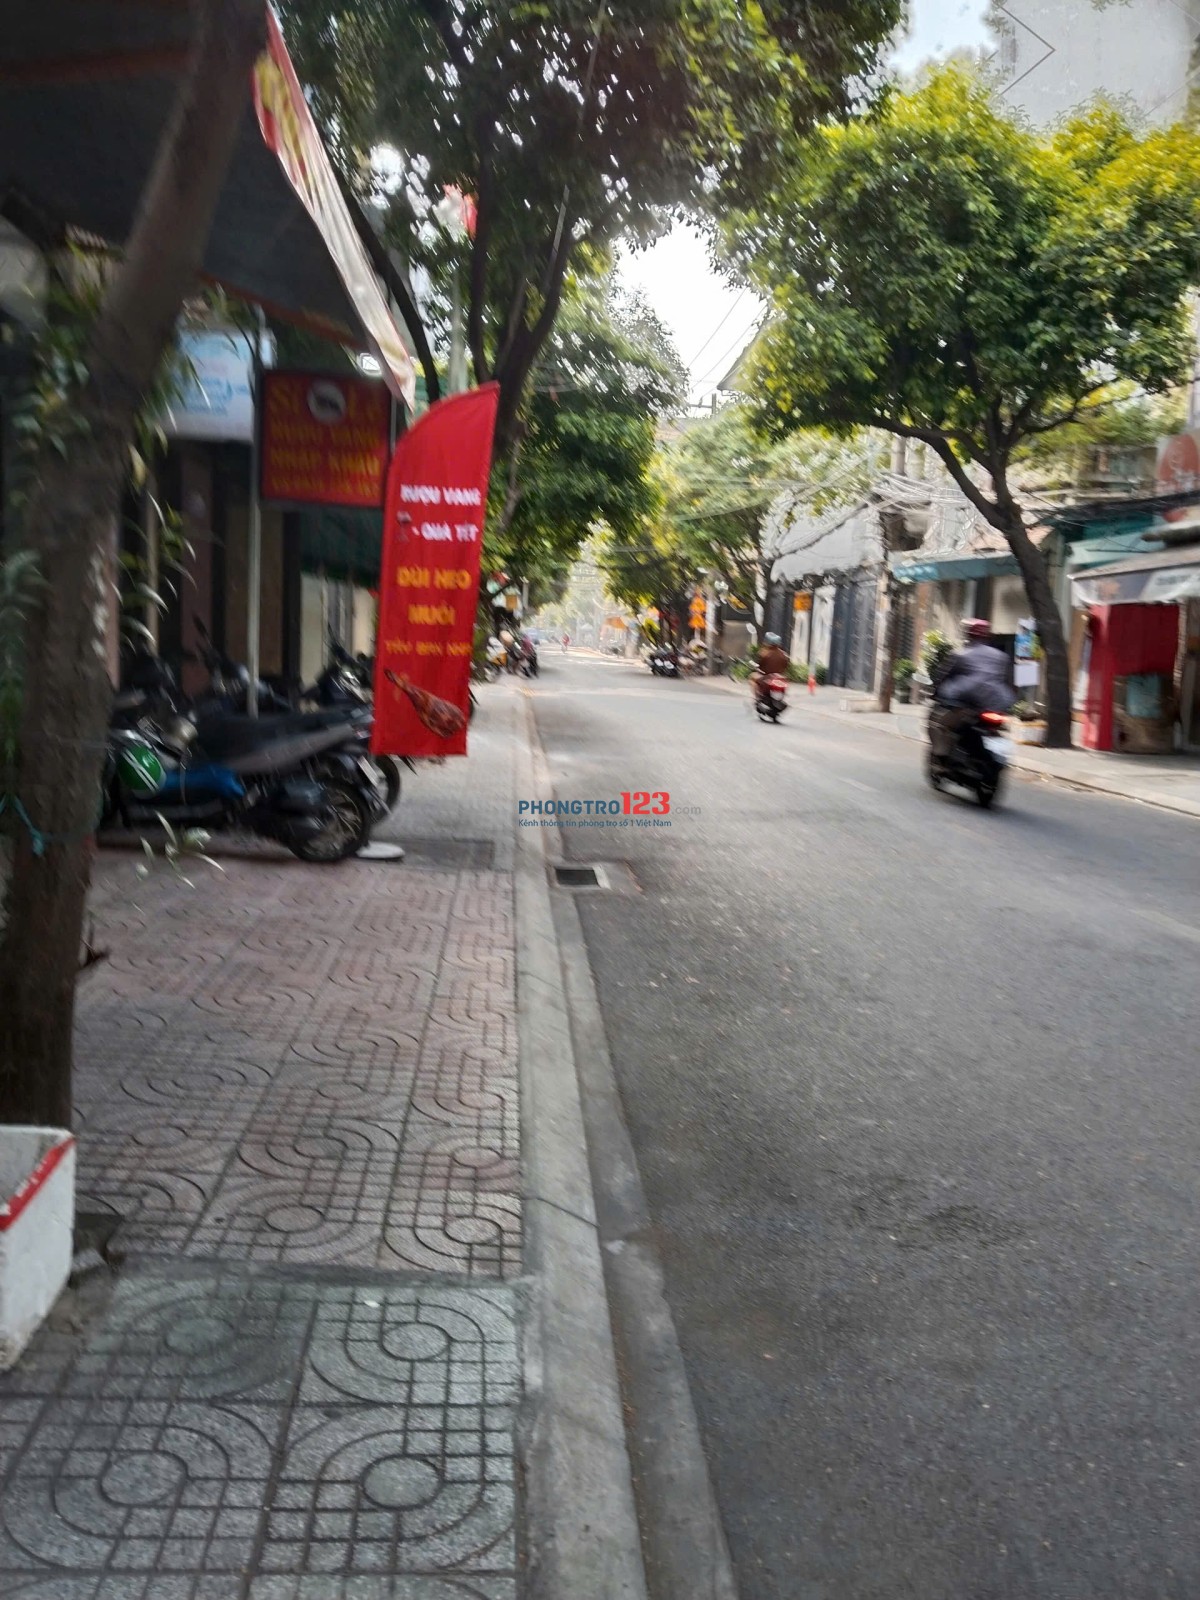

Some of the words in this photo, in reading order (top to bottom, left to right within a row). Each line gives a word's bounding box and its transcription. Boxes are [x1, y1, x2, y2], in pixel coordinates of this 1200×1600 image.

[400, 484, 441, 506] RƯỢU
[442, 487, 481, 506] VANG
[421, 521, 453, 541] QUÀ
[454, 520, 479, 541] TẾT
